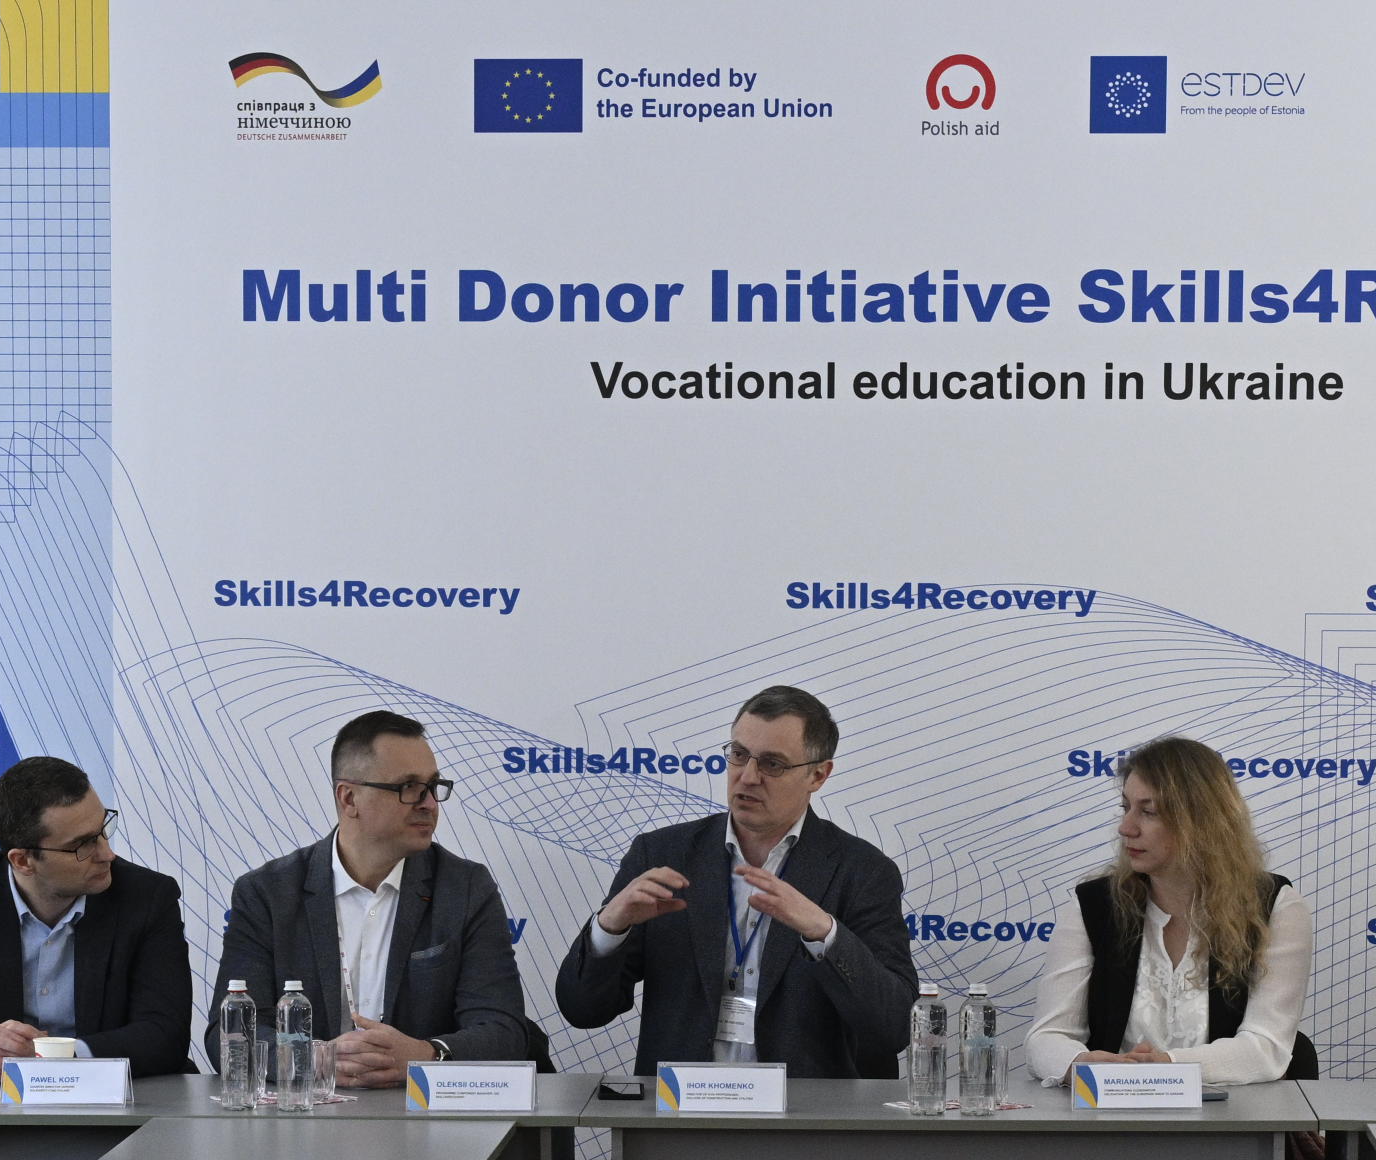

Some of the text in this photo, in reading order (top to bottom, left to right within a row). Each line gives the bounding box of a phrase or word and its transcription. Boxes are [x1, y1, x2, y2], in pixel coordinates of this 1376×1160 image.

[596, 67, 758, 93] Co-funded by
[236, 99, 316, 115] співпраця з
[596, 97, 833, 123] the European Union
[1180, 105, 1306, 118] From the people of Estonia
[237, 112, 352, 129] німеччиною
[921, 120, 1000, 136] Polish aid
[236, 133, 348, 141] DEUTSCHE ZUSAMMENARBEIT
[242, 269, 427, 323] Multi
[458, 269, 685, 324] Donor
[711, 269, 1051, 324] Initiative
[590, 361, 1344, 401] Vocational education in Ukraine
[213, 579, 521, 616] Skills4Recovery
[785, 581, 1097, 618] Skills4Recovery
[502, 746, 727, 775] Skills4Reco
[469, 1081, 509, 1089] OLEKSIUK
[708, 1082, 755, 1090] KHOMENKO
